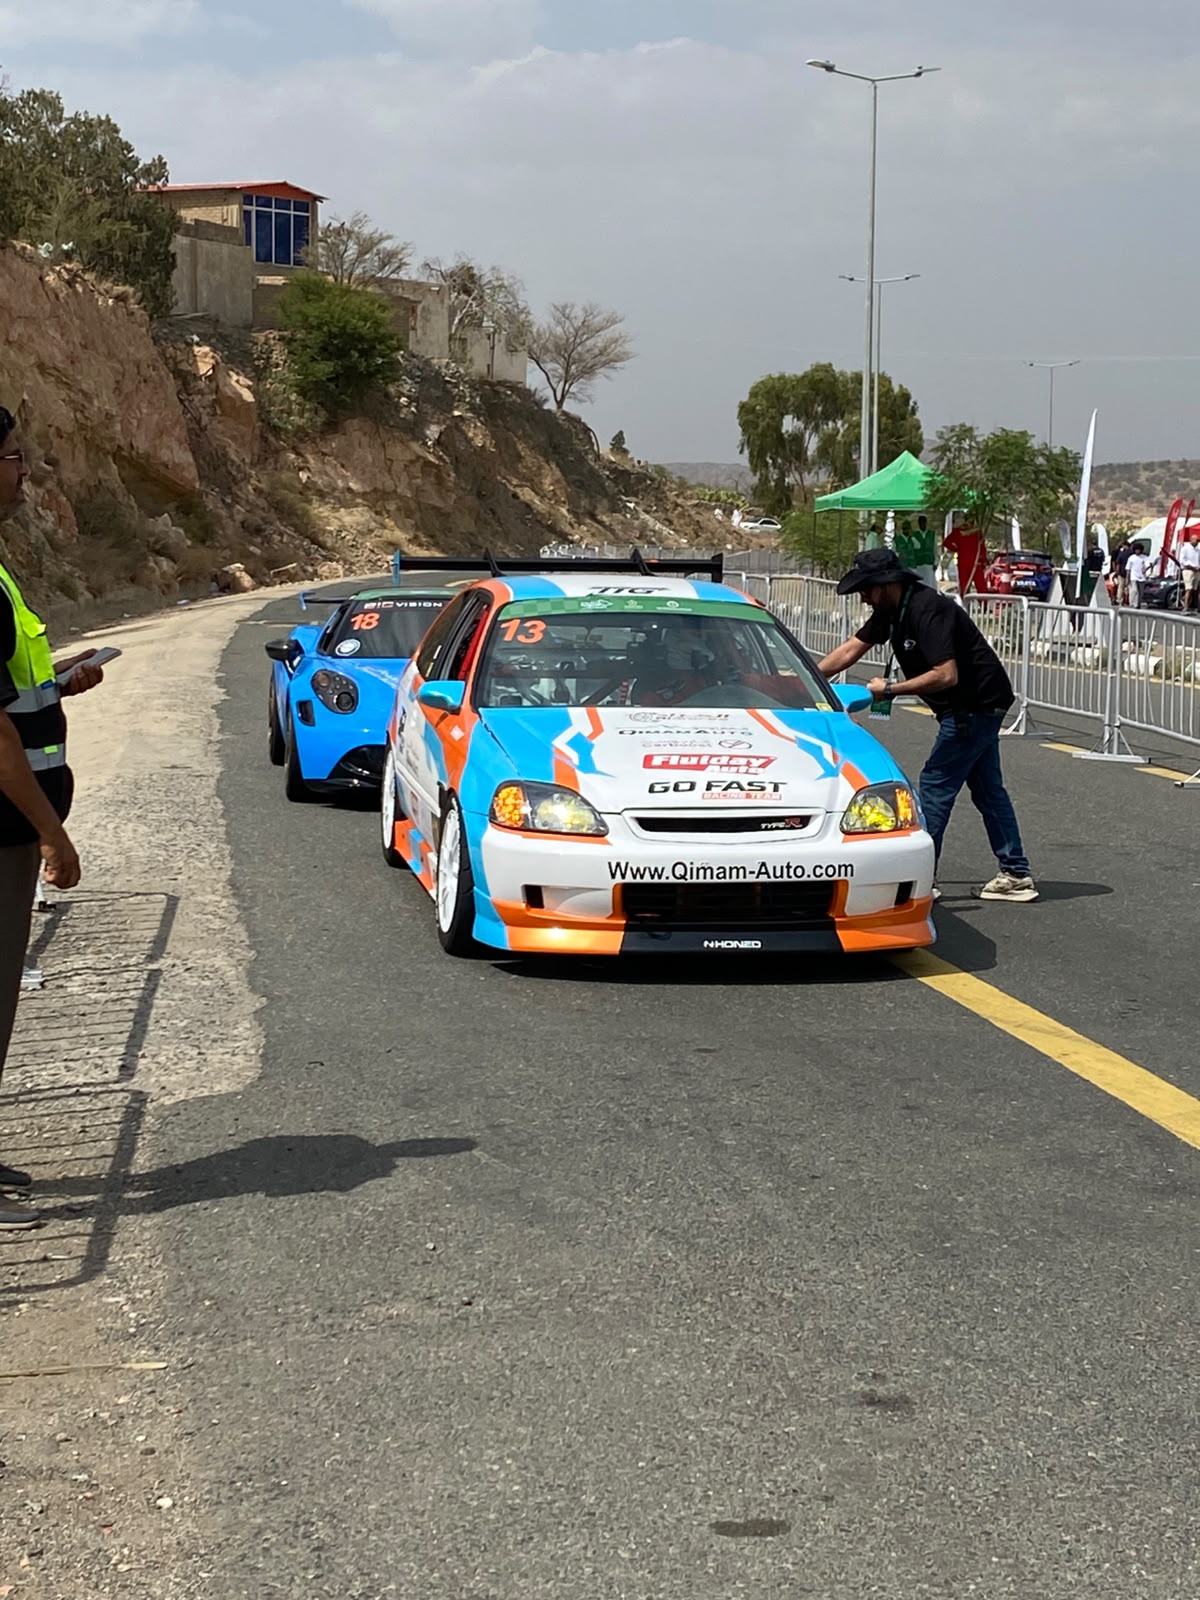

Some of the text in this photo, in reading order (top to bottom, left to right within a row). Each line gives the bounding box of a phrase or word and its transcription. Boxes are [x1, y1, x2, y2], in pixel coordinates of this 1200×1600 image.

[350, 612, 380, 631] 18
[500, 618, 547, 644] 13
[648, 780, 788, 794] GO FAST
[751, 793, 780, 801] TEAM
[608, 861, 854, 881] Www.Qimam-Auto.com
